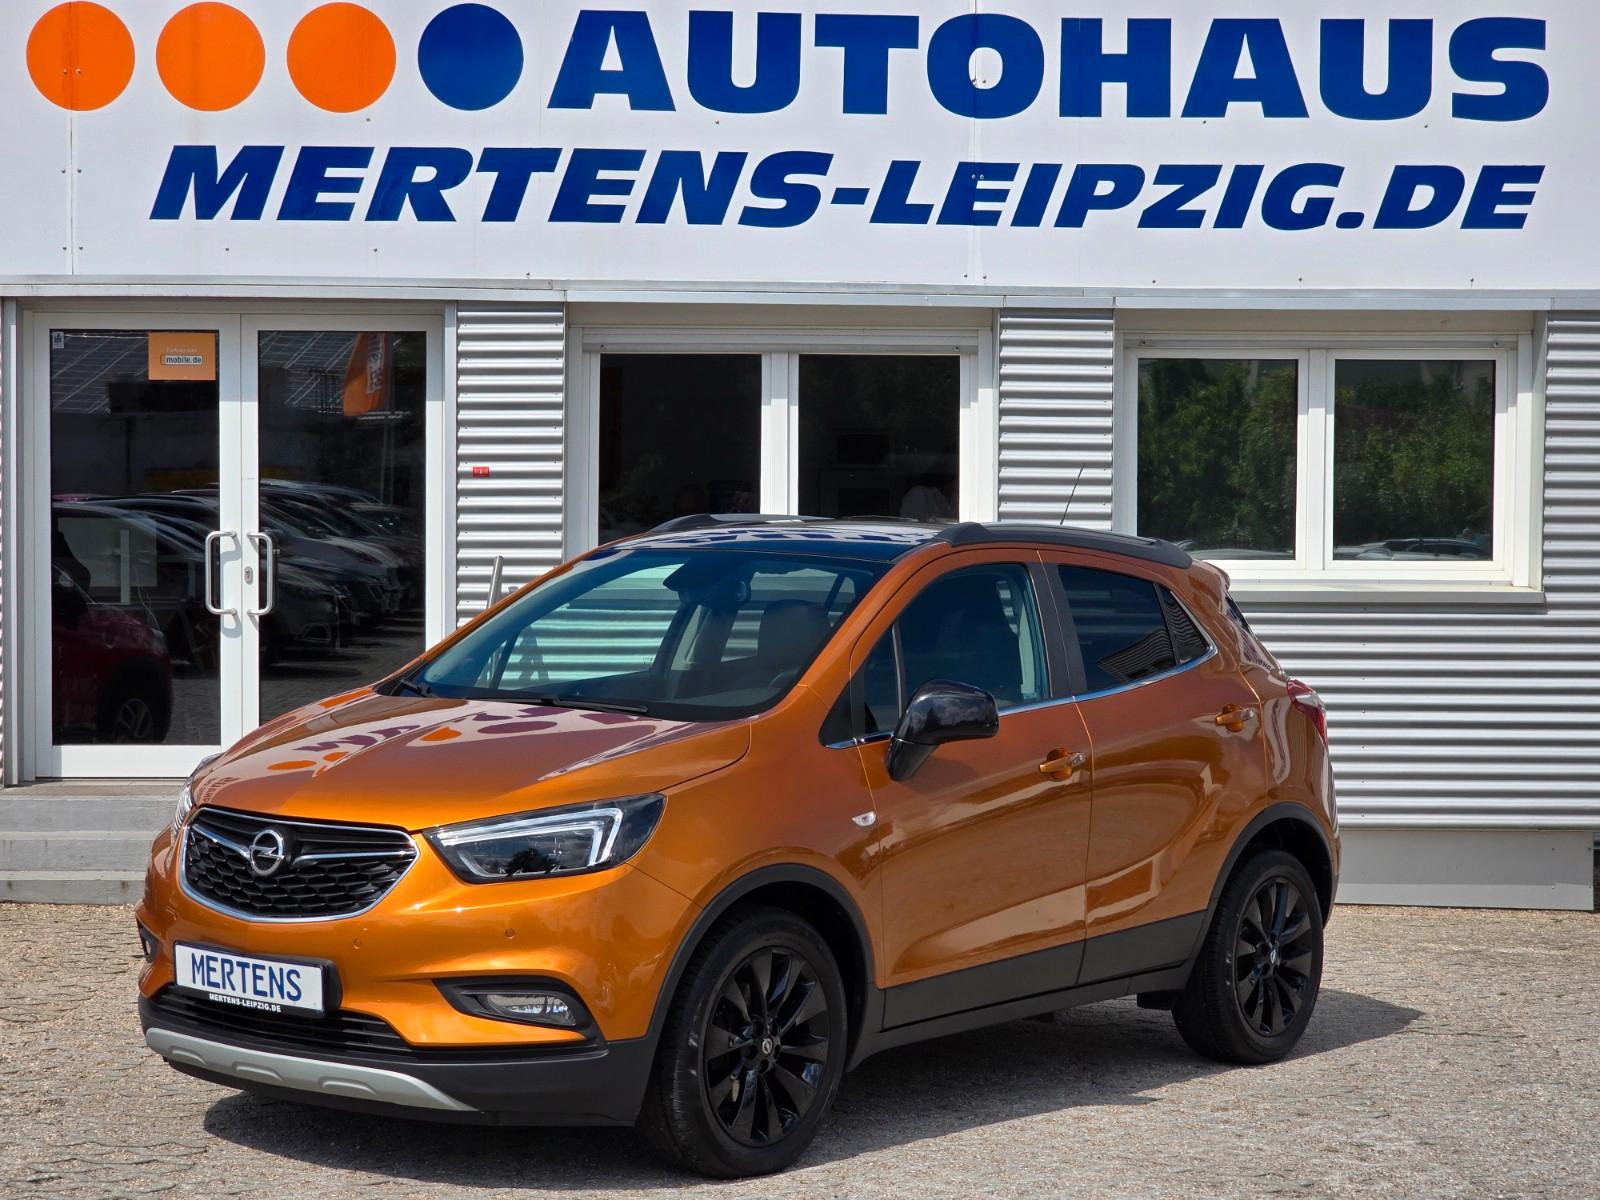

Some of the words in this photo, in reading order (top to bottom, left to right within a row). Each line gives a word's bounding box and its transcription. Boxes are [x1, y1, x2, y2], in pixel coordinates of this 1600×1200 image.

[547, 9, 1550, 121] AUTOHAUS
[149, 145, 1546, 231] MERTENS-LEIPZIG.DE
[166, 355, 202, 364] mobile.de
[192, 953, 301, 1001] MERTENS
[209, 993, 281, 1012] MERTENS-LEIPZIG.DE
